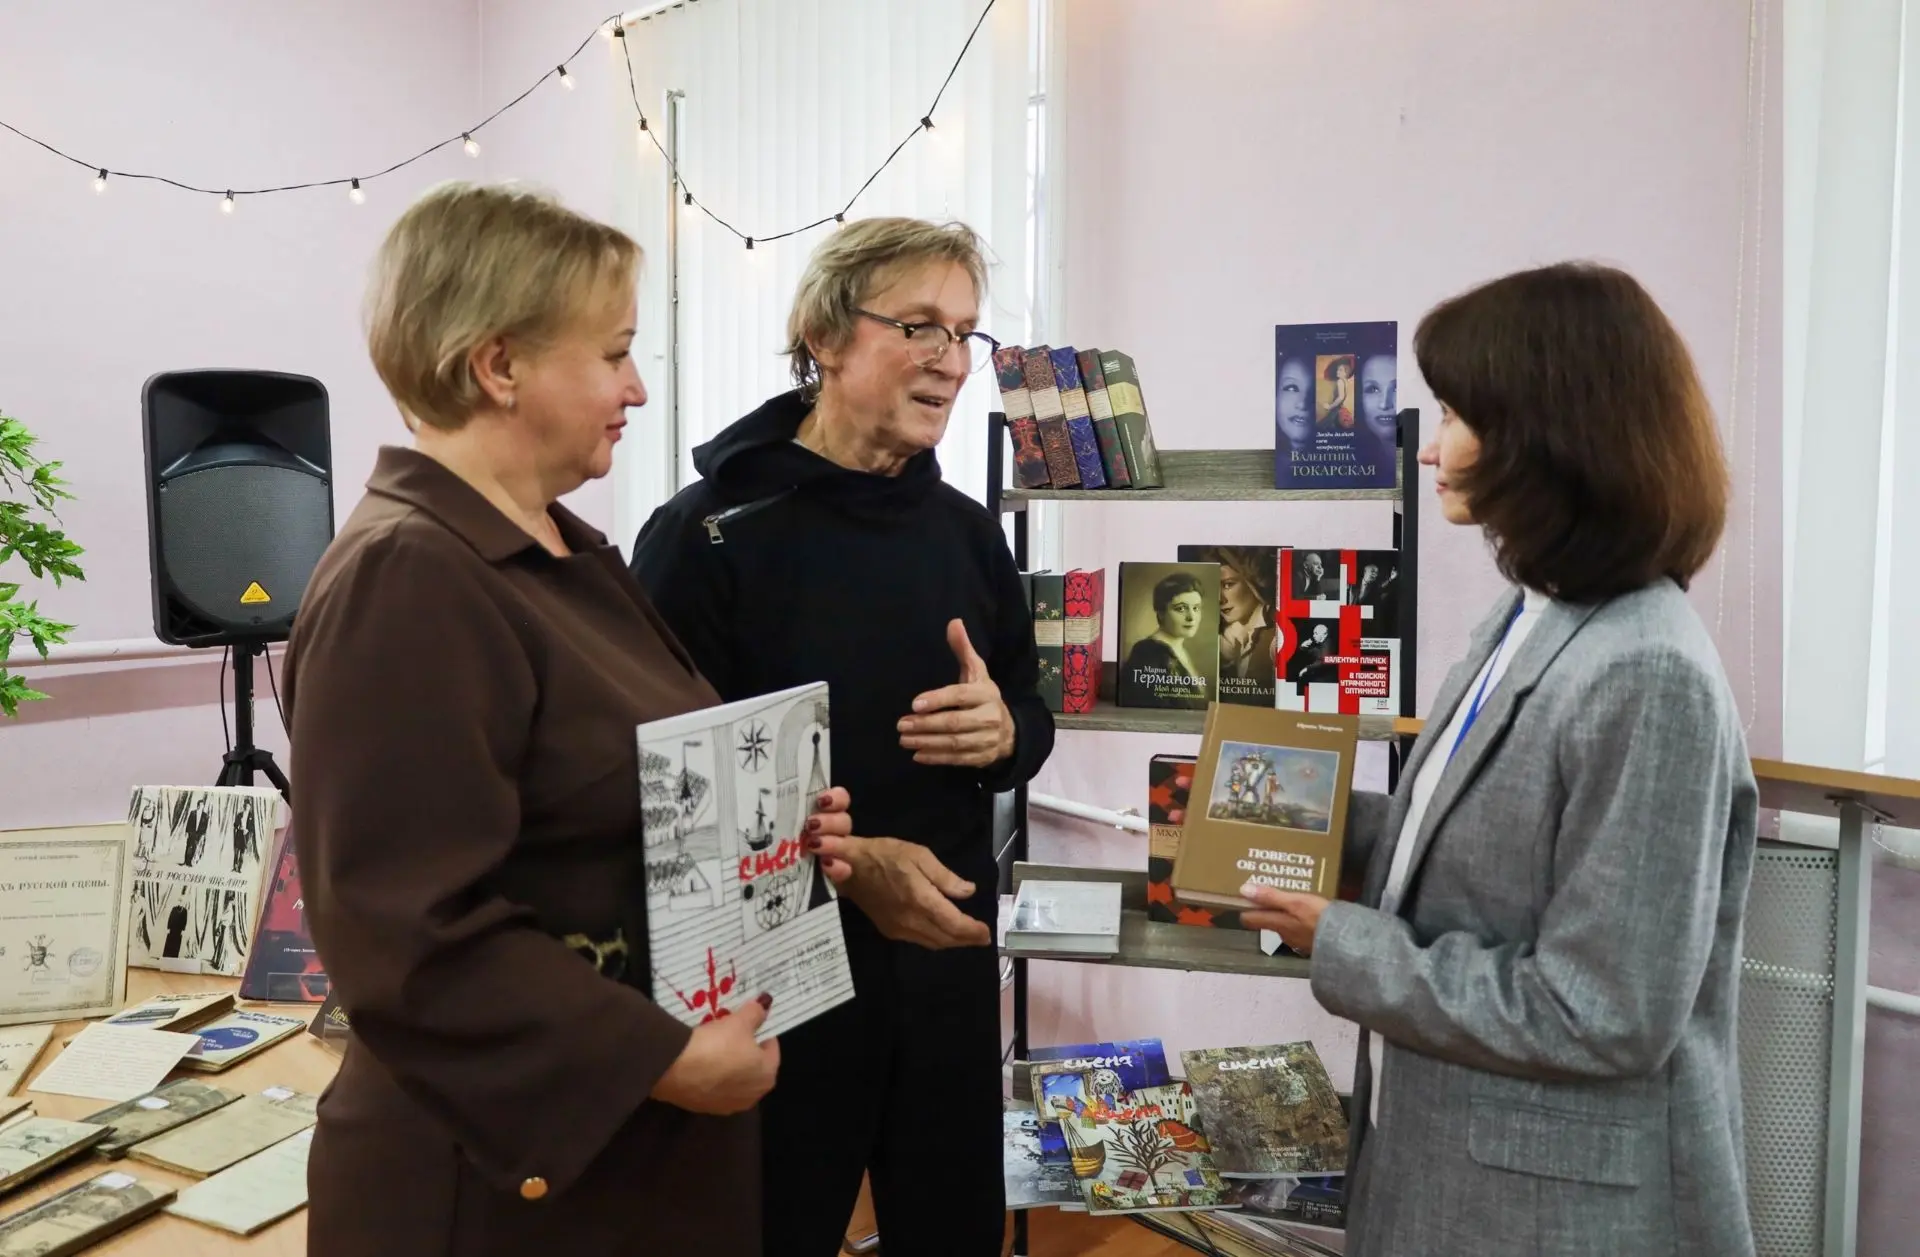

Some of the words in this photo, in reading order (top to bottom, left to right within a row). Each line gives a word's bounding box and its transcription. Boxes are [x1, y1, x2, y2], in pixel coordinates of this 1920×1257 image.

[1291, 465, 1376, 477] ТОКАРСКАЯ
[1324, 656, 1359, 664] ВАЛЕНТИН
[1360, 656, 1386, 664] ПЛУЧЕК
[1144, 665, 1166, 674] Мария
[1133, 669, 1207, 688] Германова
[1247, 847, 1315, 866] ПОВЕСТЬ
[1236, 859, 1257, 871] ОБ
[1258, 862, 1313, 878] ОДНОМ
[19, 879, 68, 891] РУССКОЙ
[1245, 874, 1312, 893] ДОМИКЕ
